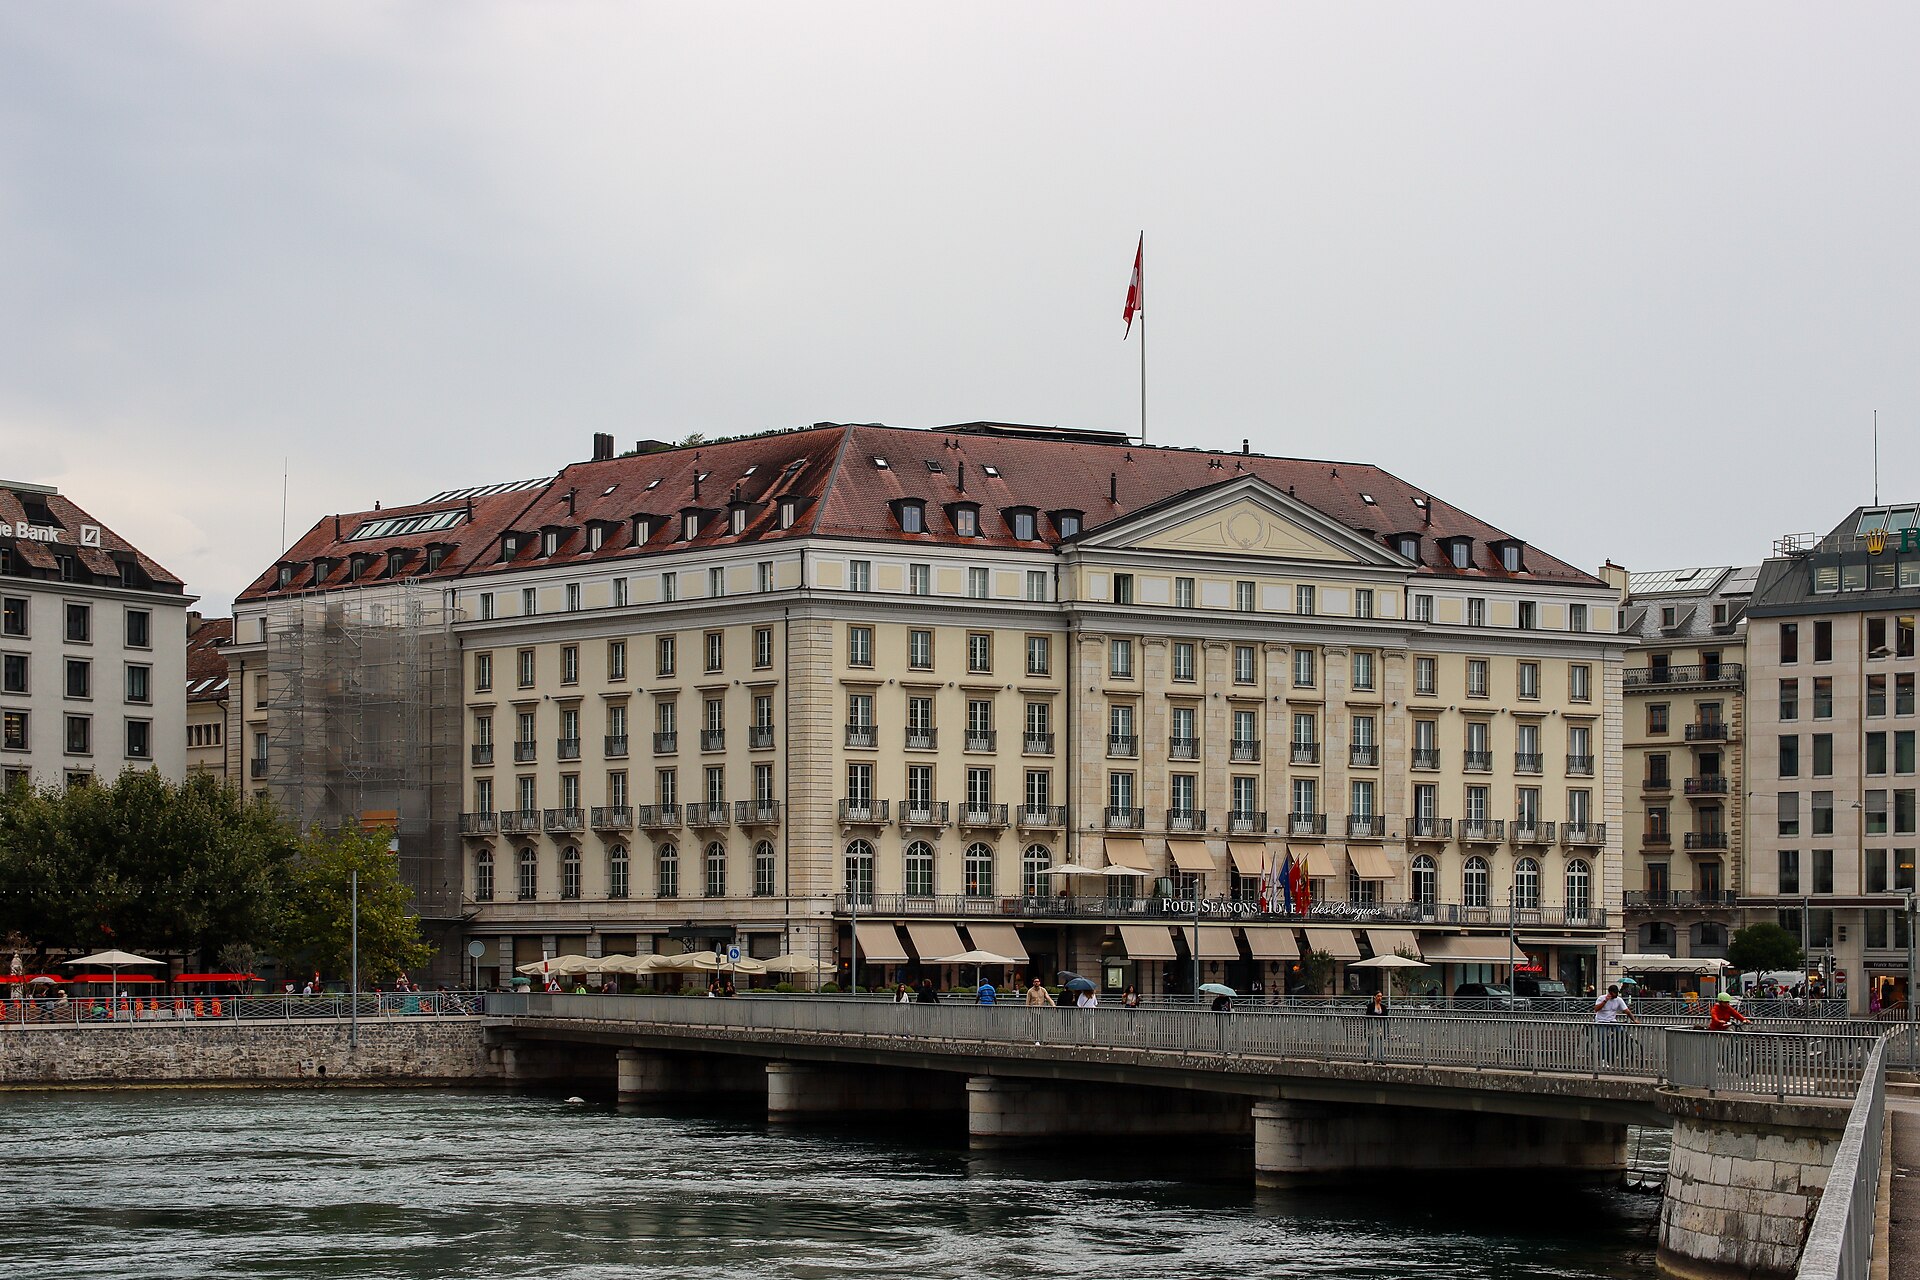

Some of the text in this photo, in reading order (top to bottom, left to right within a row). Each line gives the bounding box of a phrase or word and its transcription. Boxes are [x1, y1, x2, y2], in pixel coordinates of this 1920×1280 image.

[0, 521, 59, 543] e Bank
[1311, 901, 1331, 914] des
[1331, 901, 1381, 920] Bergues
